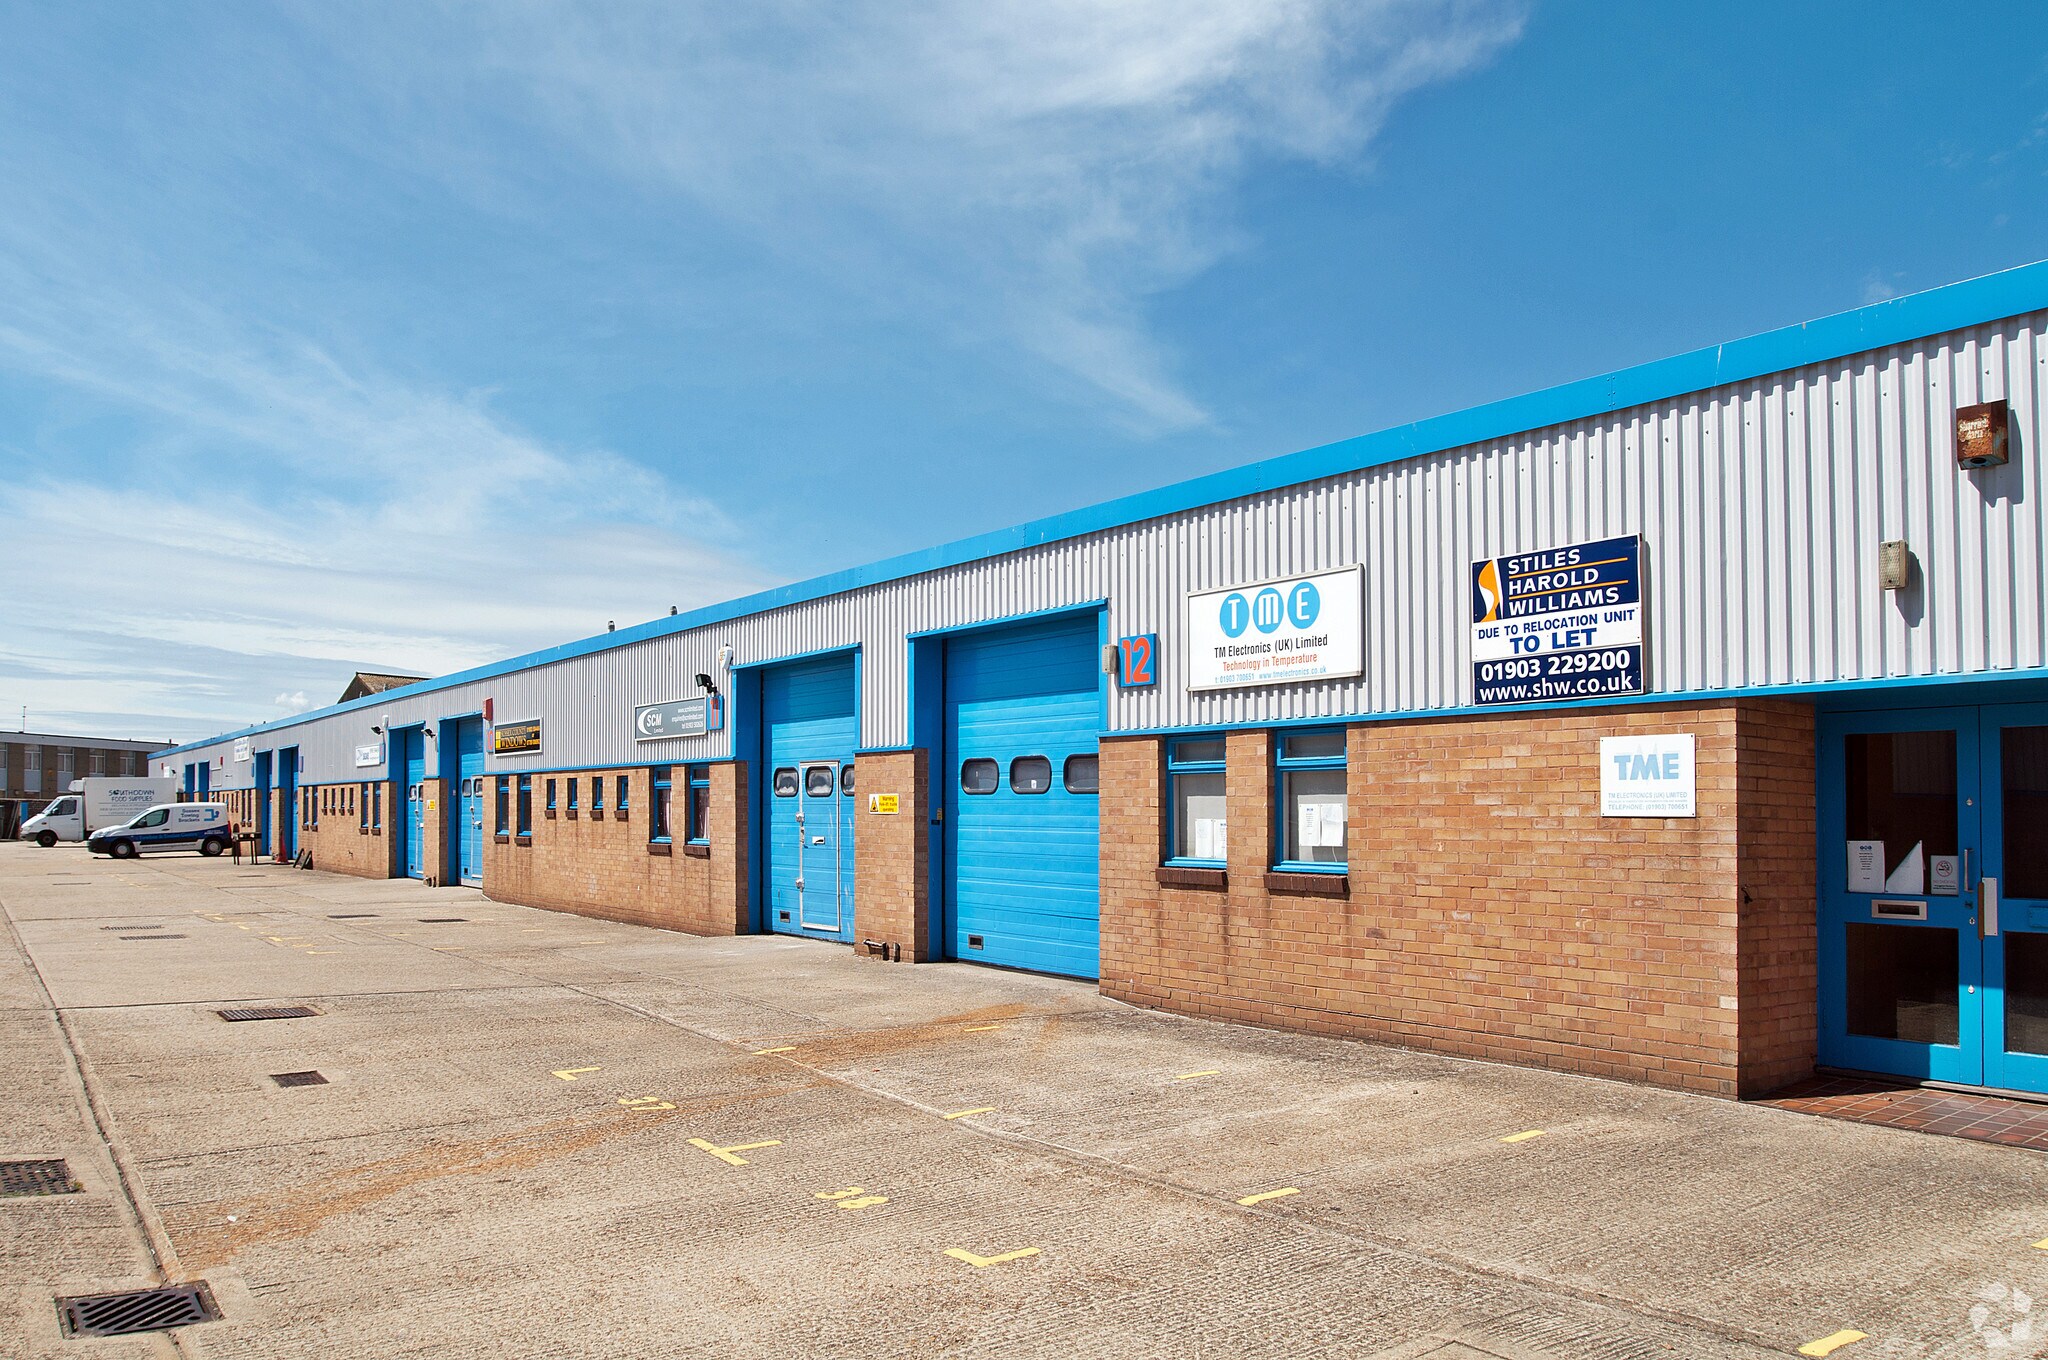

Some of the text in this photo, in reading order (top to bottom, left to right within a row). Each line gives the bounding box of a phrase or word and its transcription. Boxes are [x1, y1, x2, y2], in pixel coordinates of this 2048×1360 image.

[1508, 549, 1580, 575] STILES
[1508, 568, 1599, 596] HAROLD
[1227, 586, 1311, 631] TME
[1509, 587, 1620, 616] WILLIAMS
[1478, 609, 1635, 639] DUE TO RELOCATION UNIT
[1214, 634, 1328, 658] TM Electronics (UK) Limited
[1510, 627, 1598, 654] TO LET
[1122, 637, 1150, 684] 12
[1223, 653, 1318, 672] Technology in Temperature
[1481, 650, 1631, 682] 01903 229200
[1479, 670, 1634, 701] www.shw.co.uk
[646, 713, 662, 727] SCM
[1613, 753, 1679, 780] TME
[814, 1186, 889, 1209] 38
